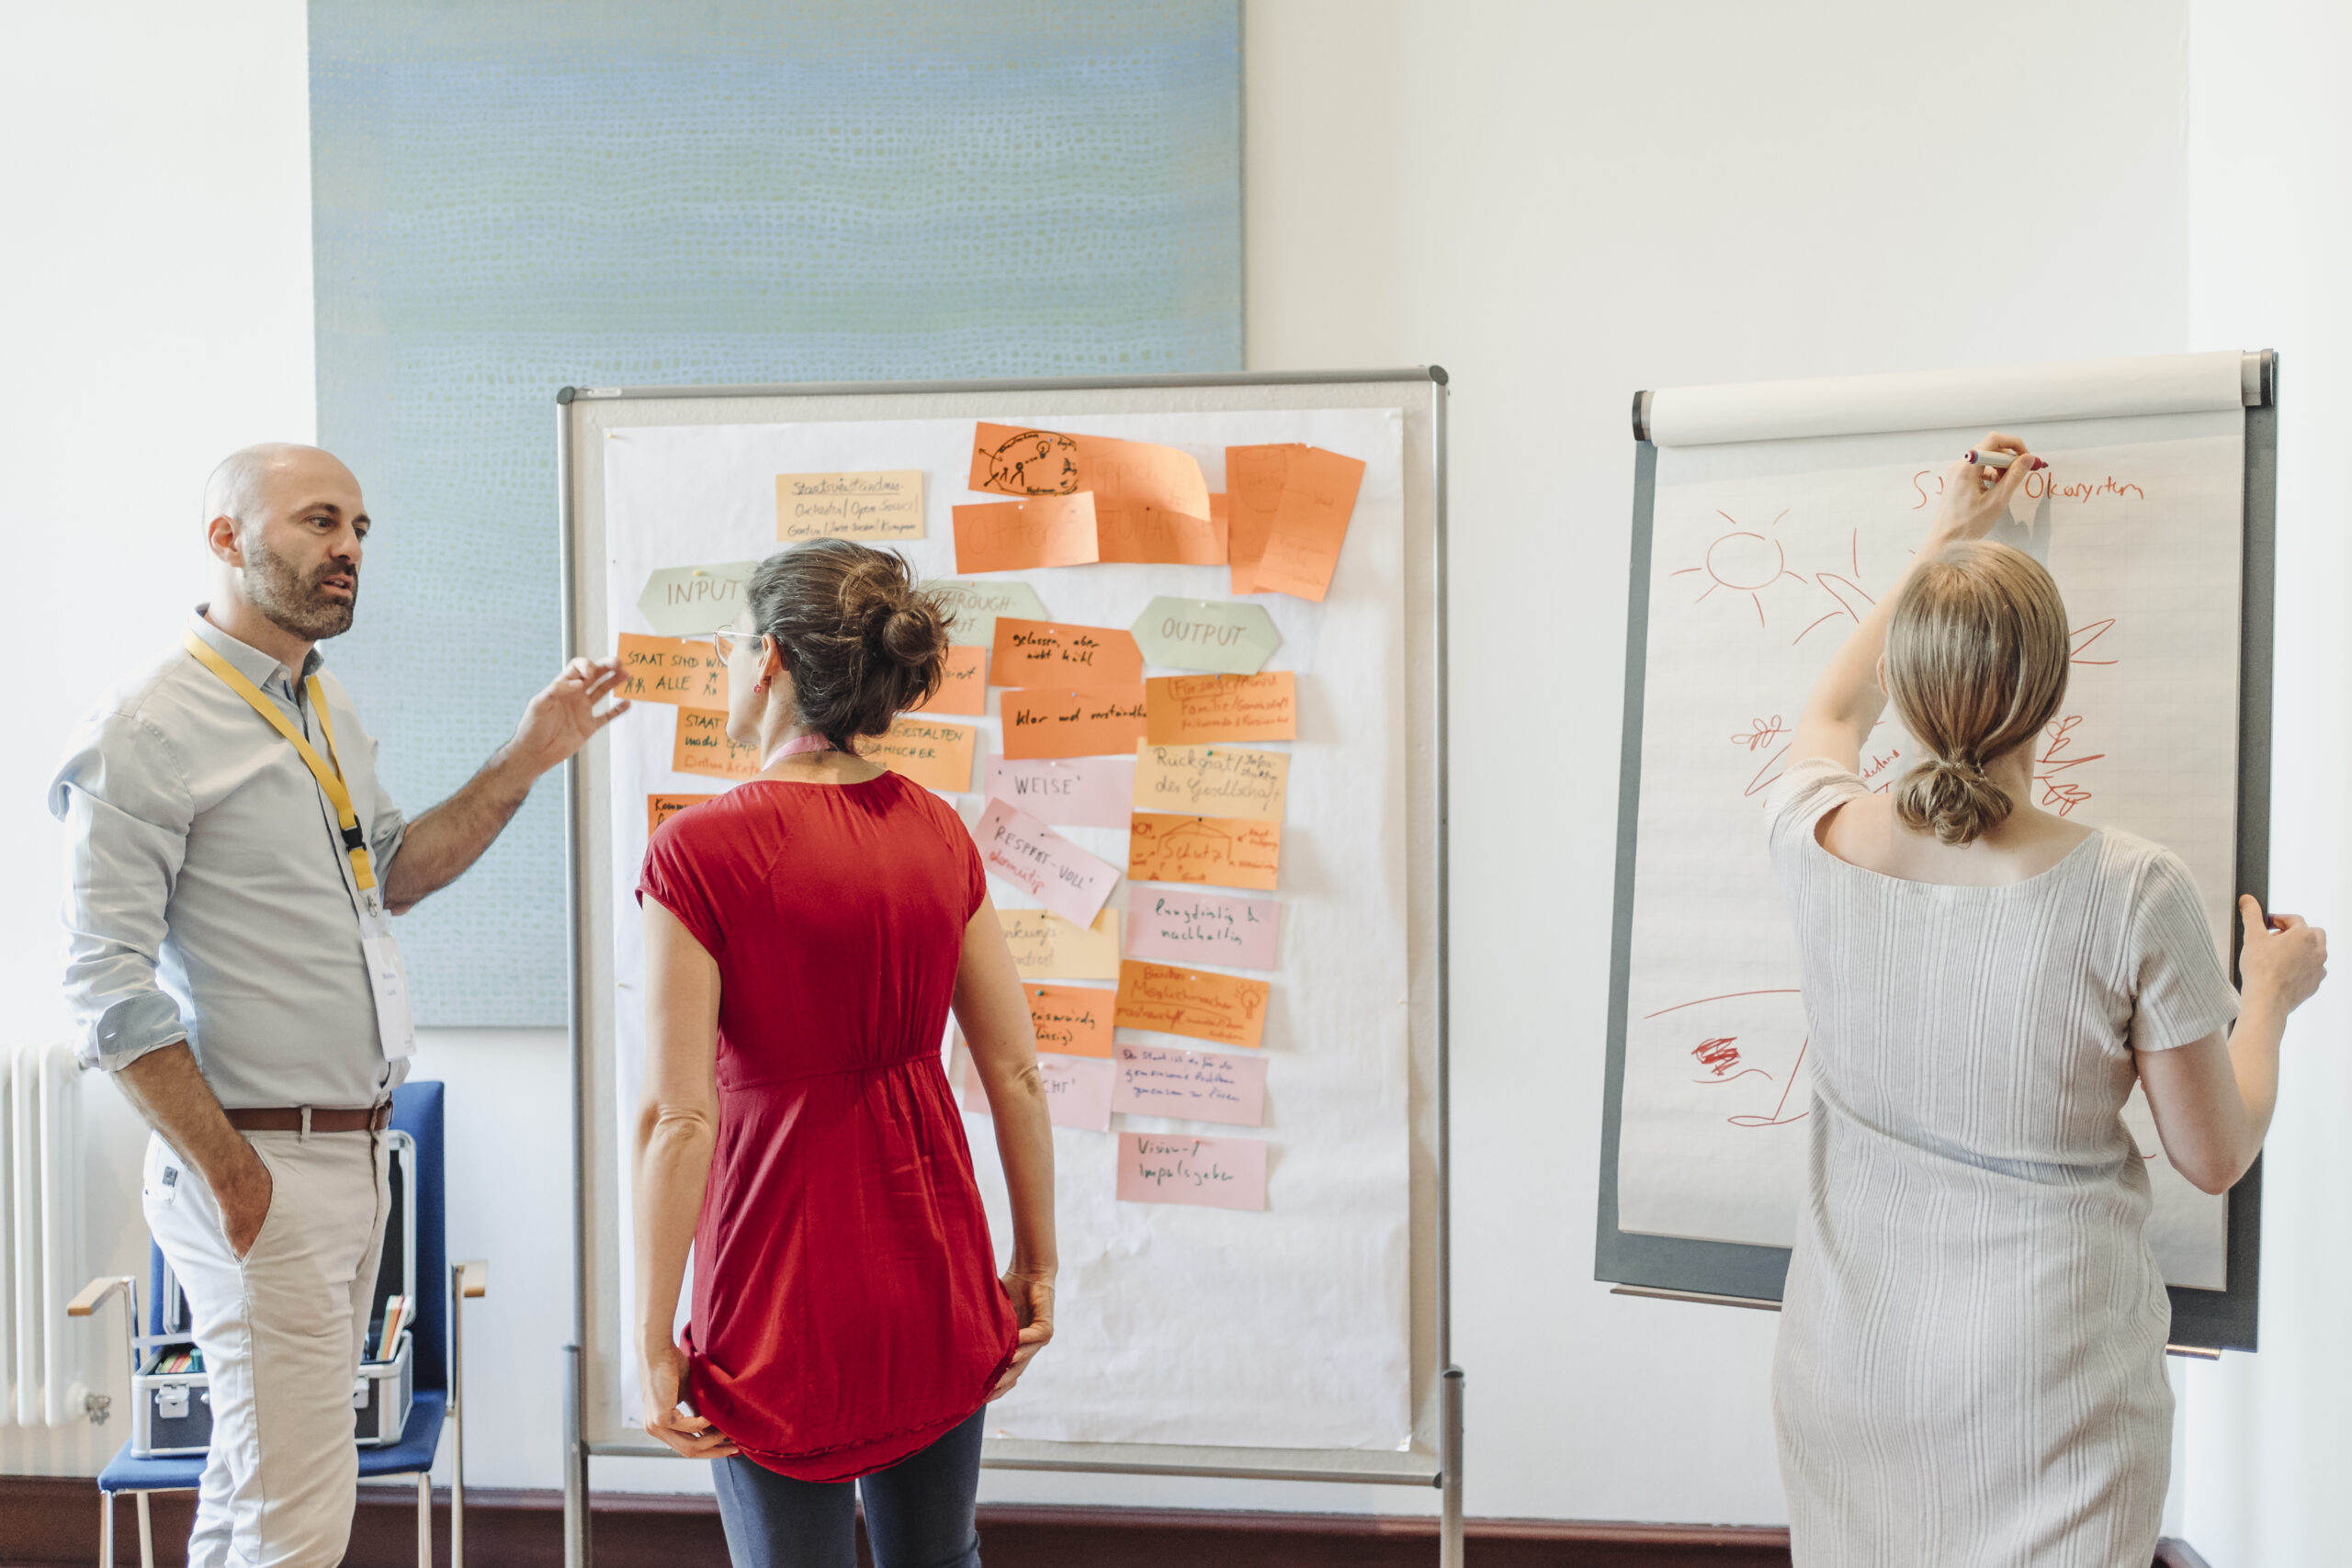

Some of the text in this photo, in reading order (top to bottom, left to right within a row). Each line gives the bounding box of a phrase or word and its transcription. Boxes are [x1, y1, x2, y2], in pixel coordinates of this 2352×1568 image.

[667, 580, 742, 606] INPUT
[1012, 631, 1100, 648] gelassen, aber
[1161, 617, 1248, 647] OUTPUT
[626, 650, 666, 667] STAAT
[670, 654, 699, 669] SIND
[1062, 649, 1093, 666] kühl
[655, 675, 691, 691] ALLE
[684, 714, 723, 730] STAAT
[1016, 704, 1147, 727] klar und verständli
[893, 723, 964, 741] GESTALTEN
[1186, 776, 1281, 811] Gesellschaft
[1162, 835, 1222, 863] Schutz
[1161, 924, 1243, 947] nachhaltig
[1138, 1160, 1234, 1187] Impulsgeber
